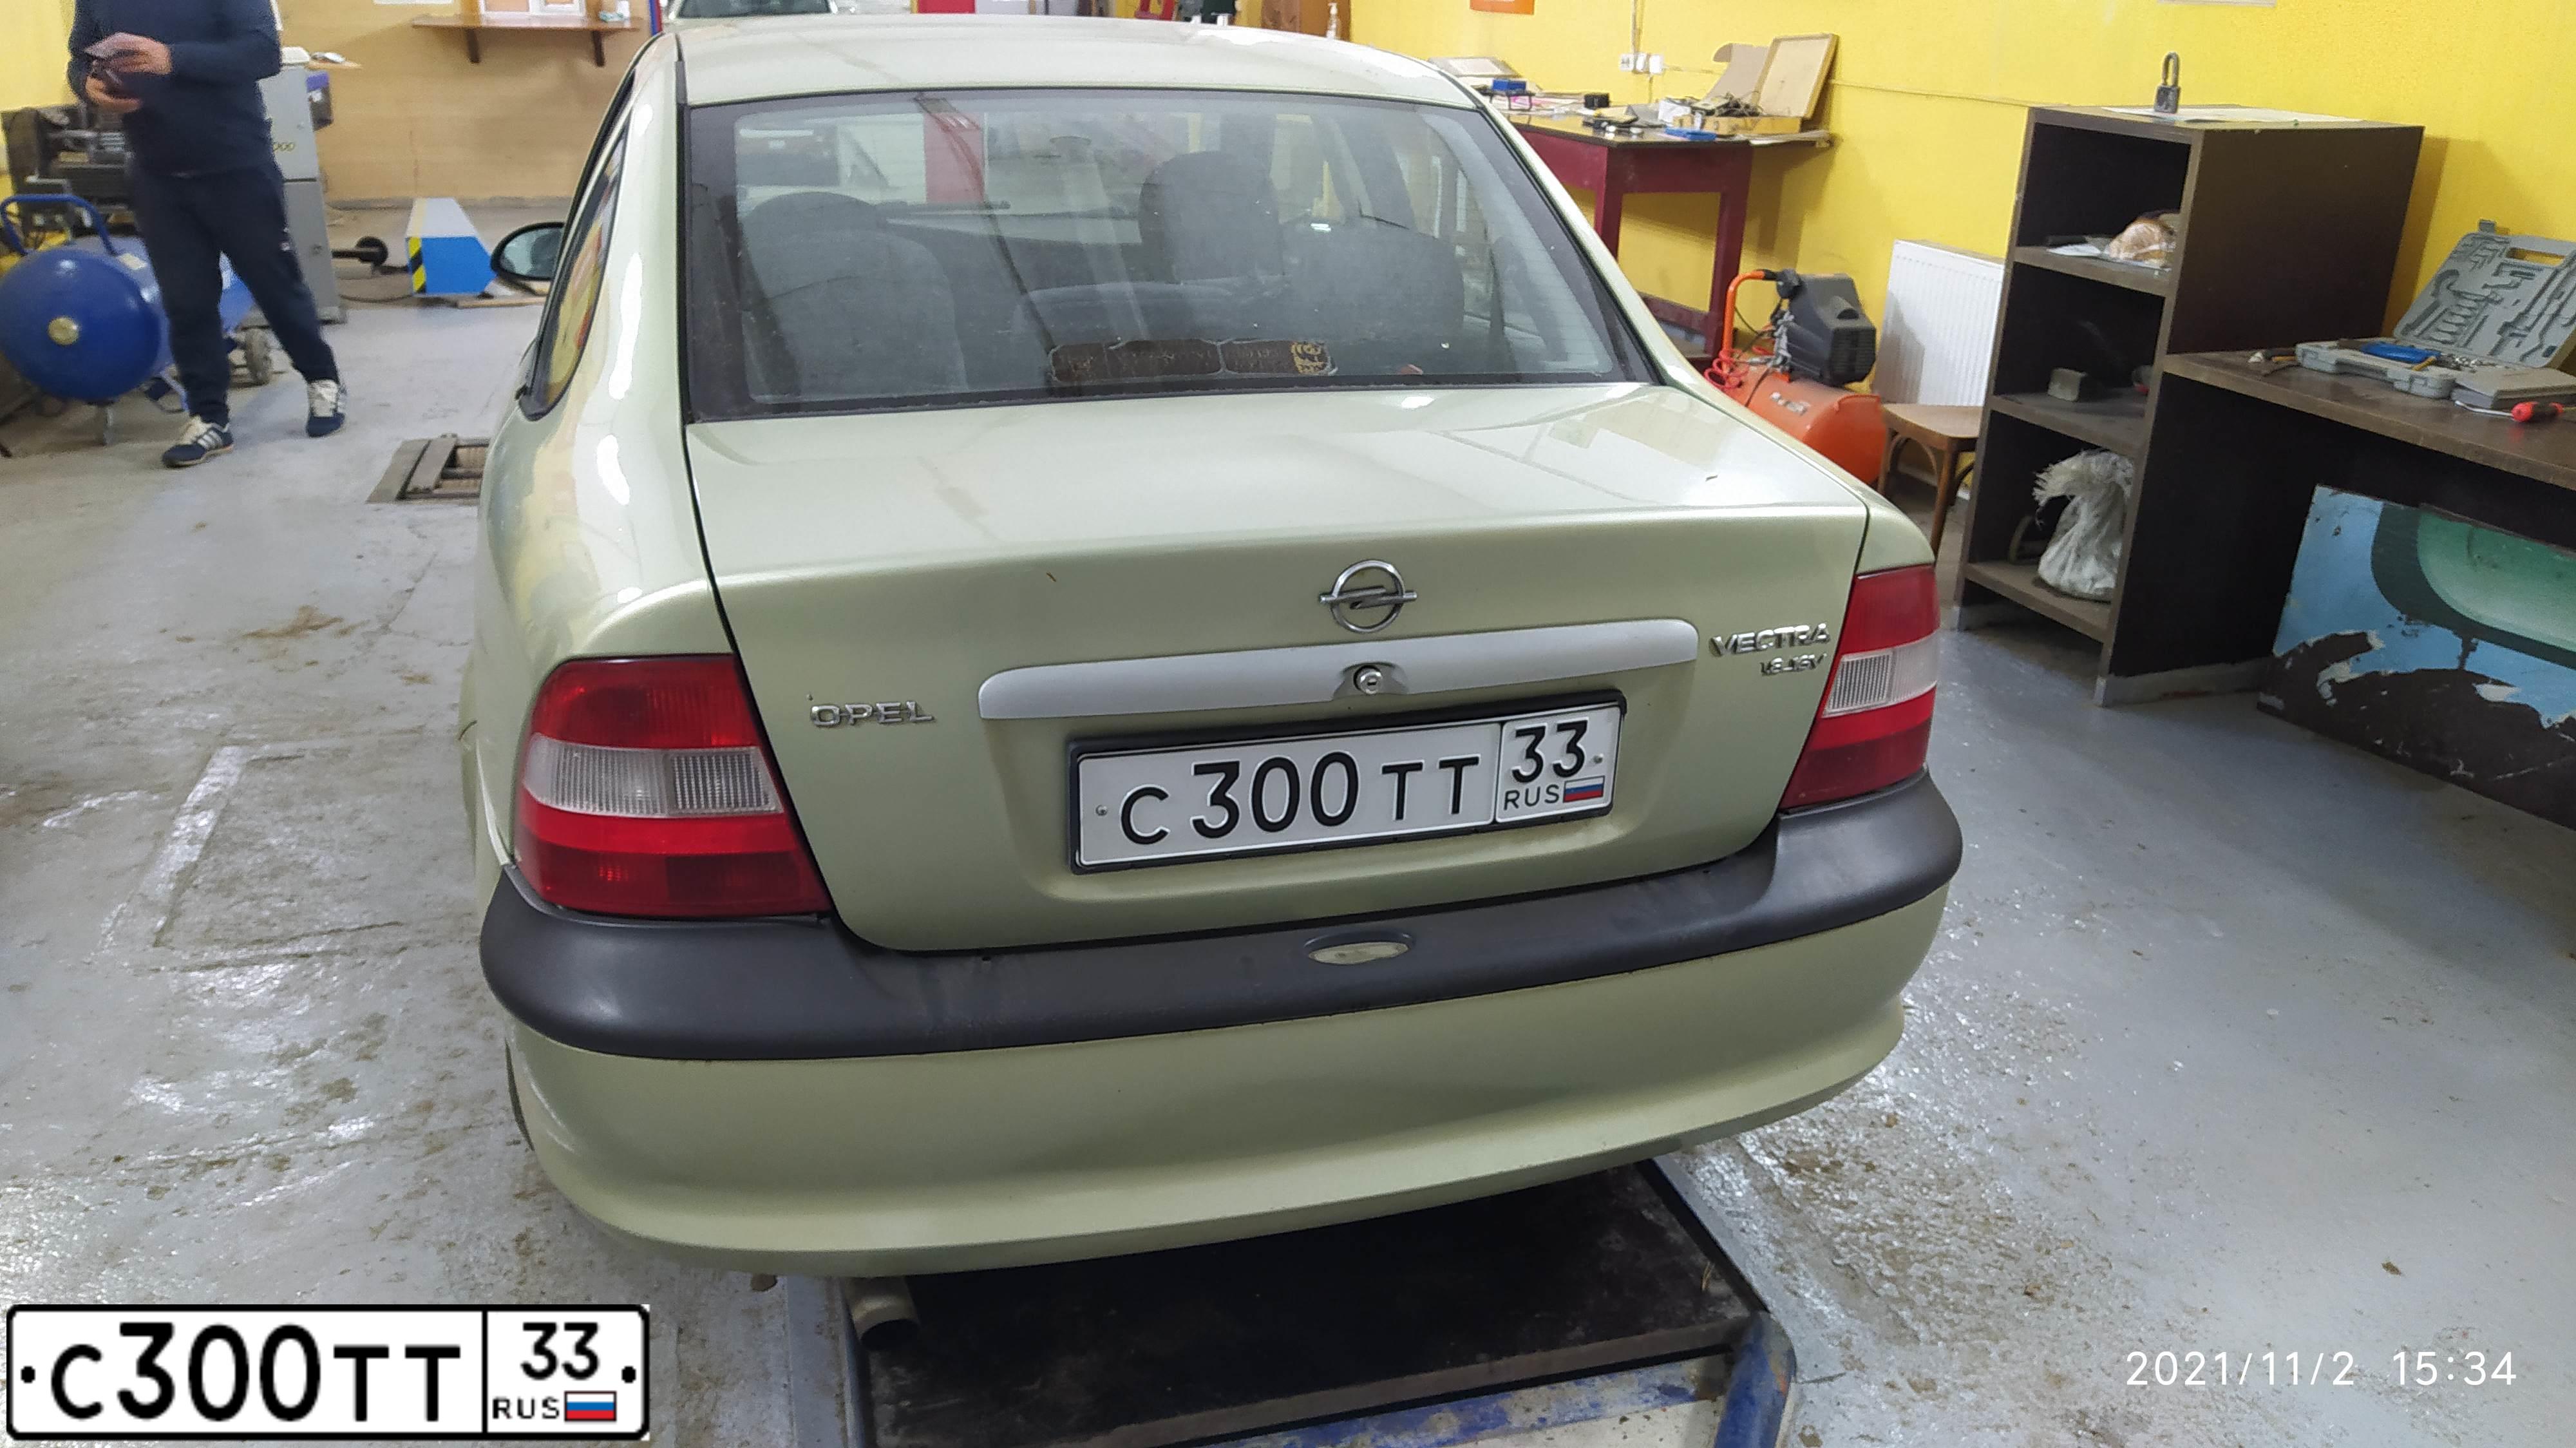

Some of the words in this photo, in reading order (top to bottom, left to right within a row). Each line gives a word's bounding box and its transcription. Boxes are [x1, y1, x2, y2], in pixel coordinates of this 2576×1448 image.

[1709, 622, 1830, 657] VECTRA
[811, 700, 936, 727] OPEL
[1511, 720, 1589, 783] 33
[1504, 784, 1560, 810] RUS
